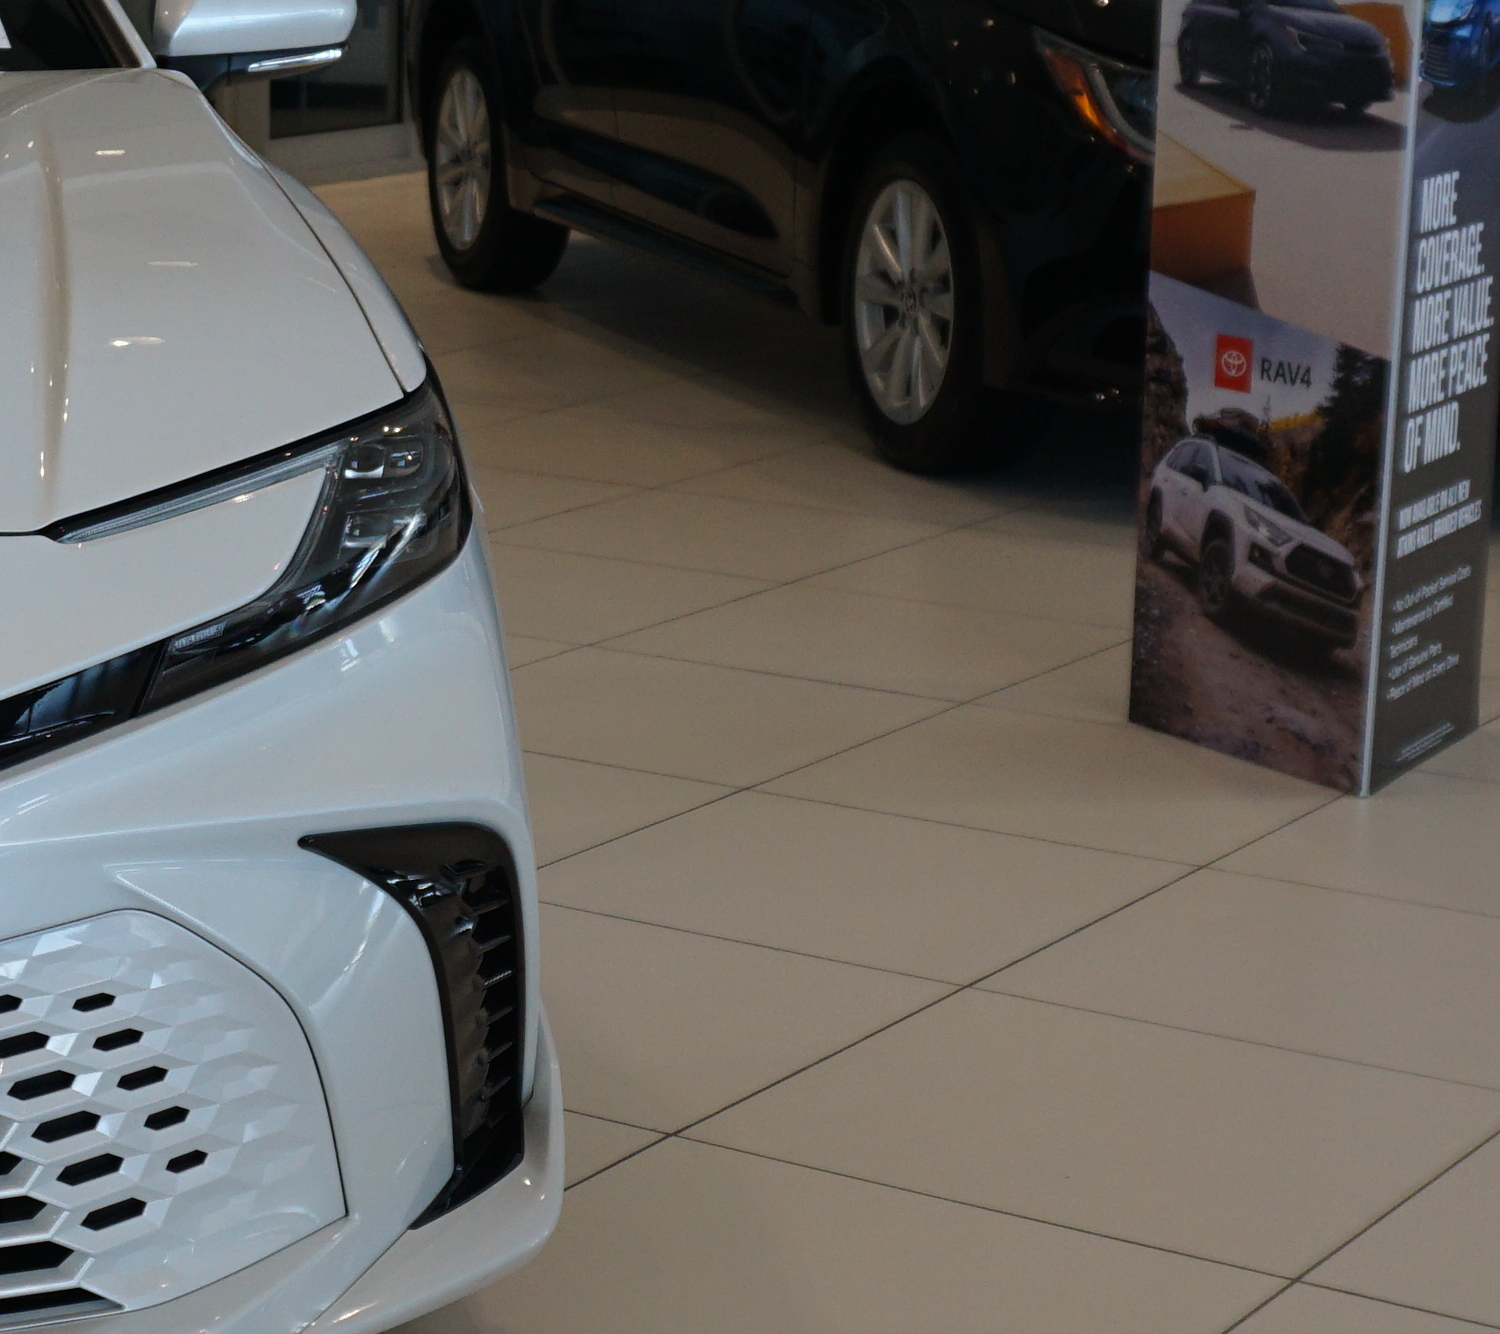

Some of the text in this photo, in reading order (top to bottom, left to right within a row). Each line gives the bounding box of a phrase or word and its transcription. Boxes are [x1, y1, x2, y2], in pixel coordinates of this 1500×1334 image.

[1420, 171, 1460, 234] MORE
[1417, 222, 1485, 294] COVERAGE.
[1412, 275, 1494, 354] MORE VALUE.
[1260, 357, 1312, 389] RAV4
[1408, 333, 1490, 415] MORE PEACE
[1404, 400, 1460, 474] OF MIND.
